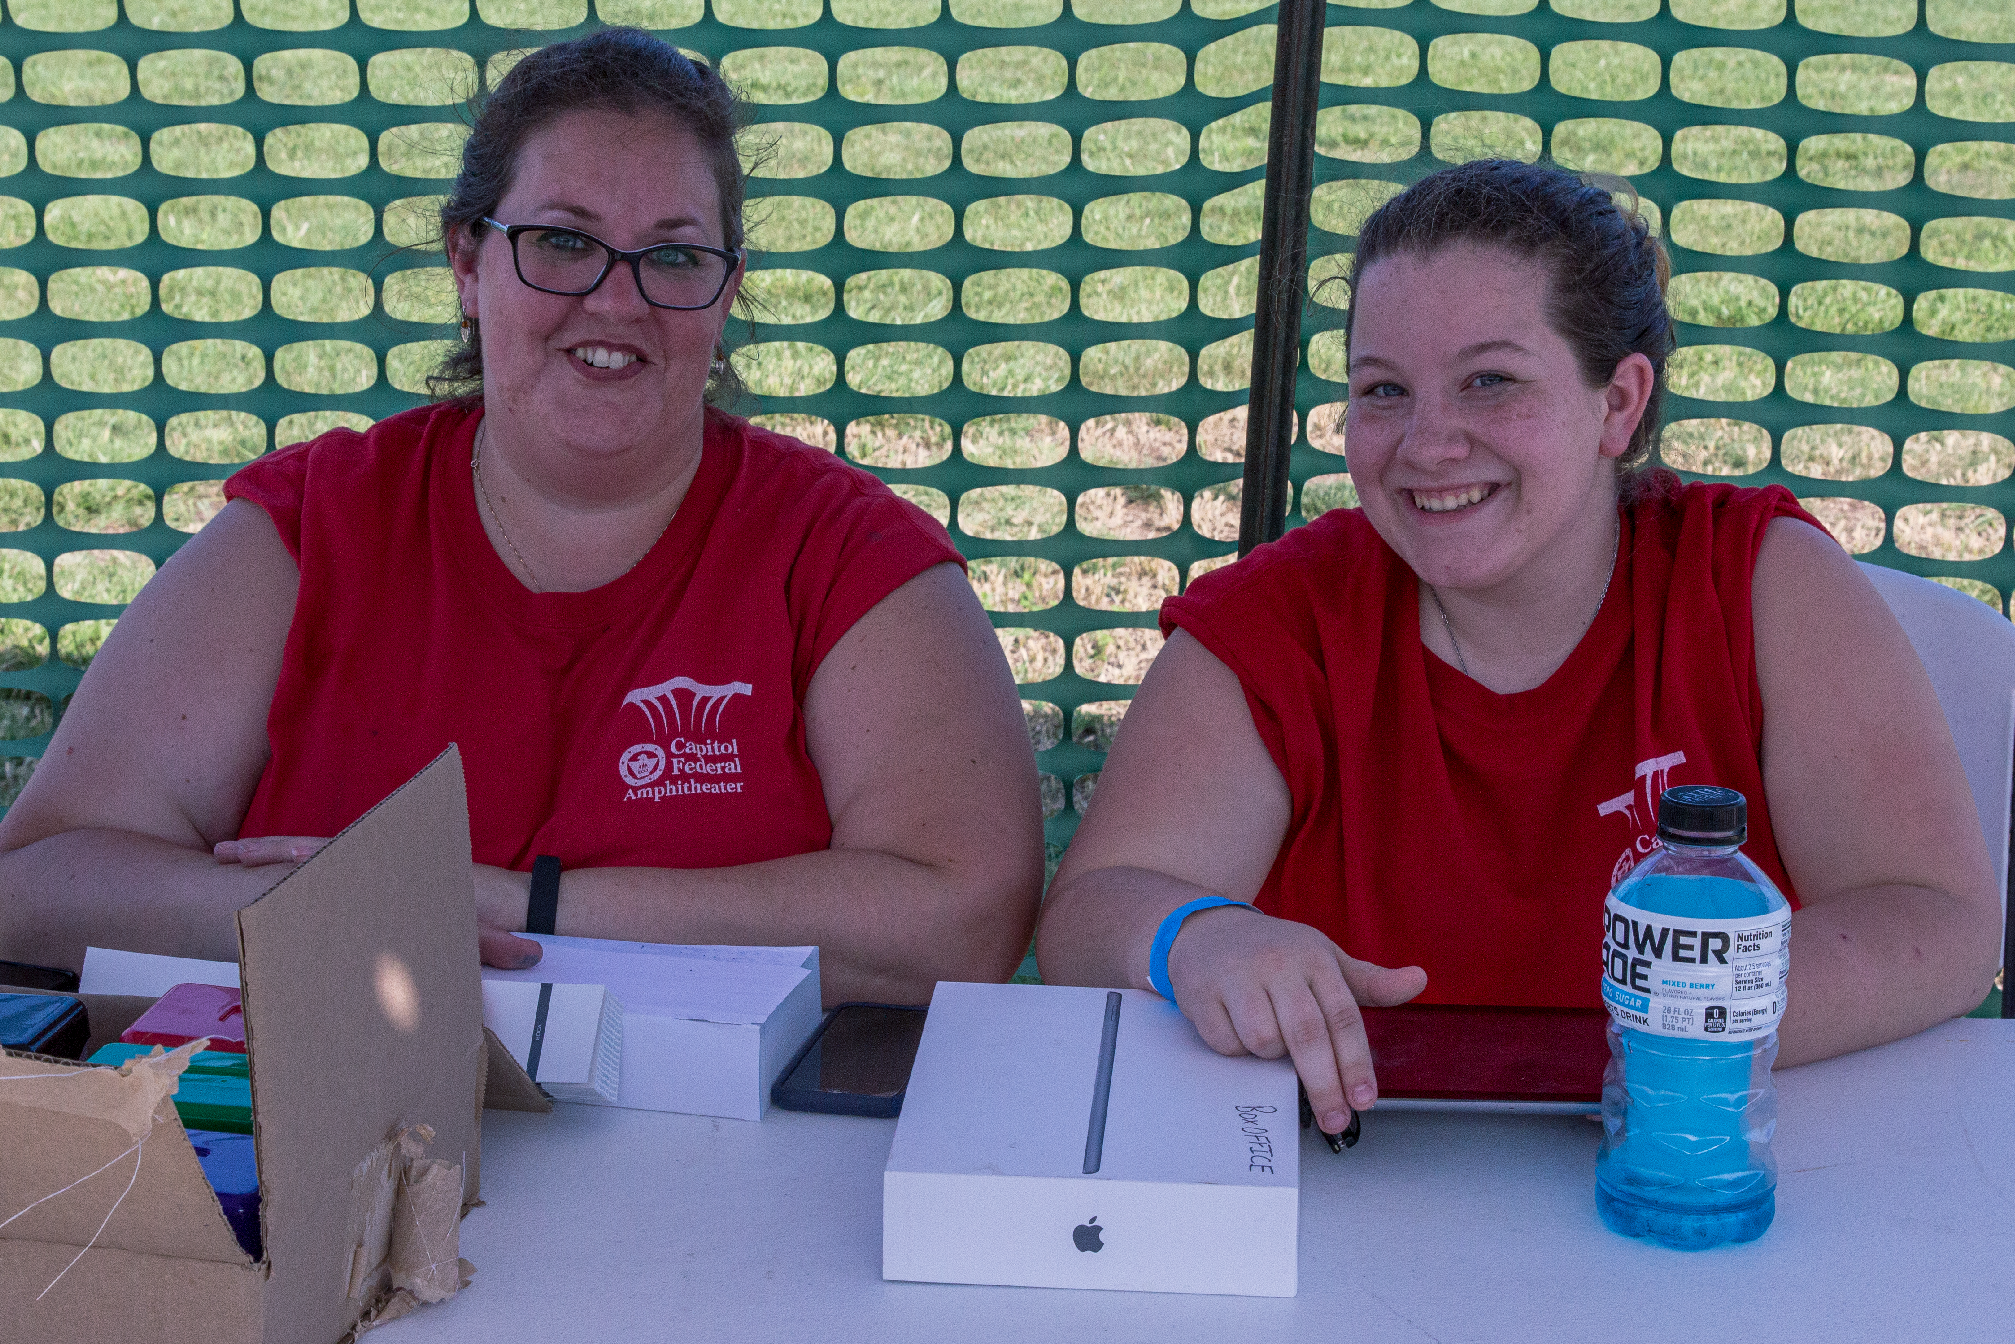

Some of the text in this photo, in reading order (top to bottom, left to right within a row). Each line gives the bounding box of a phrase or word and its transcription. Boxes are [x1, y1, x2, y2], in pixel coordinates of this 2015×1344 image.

[670, 737, 739, 757] Capitol
[671, 755, 742, 775] Federal
[623, 779, 744, 801] Amphitheater
[1736, 930, 1773, 943] Nutrition
[1736, 942, 1761, 953] Facts
[1661, 979, 1716, 990] MIXED BERRY
[1615, 991, 1642, 1008] SUGAR
[1620, 1009, 1650, 1026] DRINK
[1673, 1007, 1681, 1015] FL
[1713, 1008, 1719, 1019] 0
[1234, 1105, 1278, 1175] Box OFFICE
